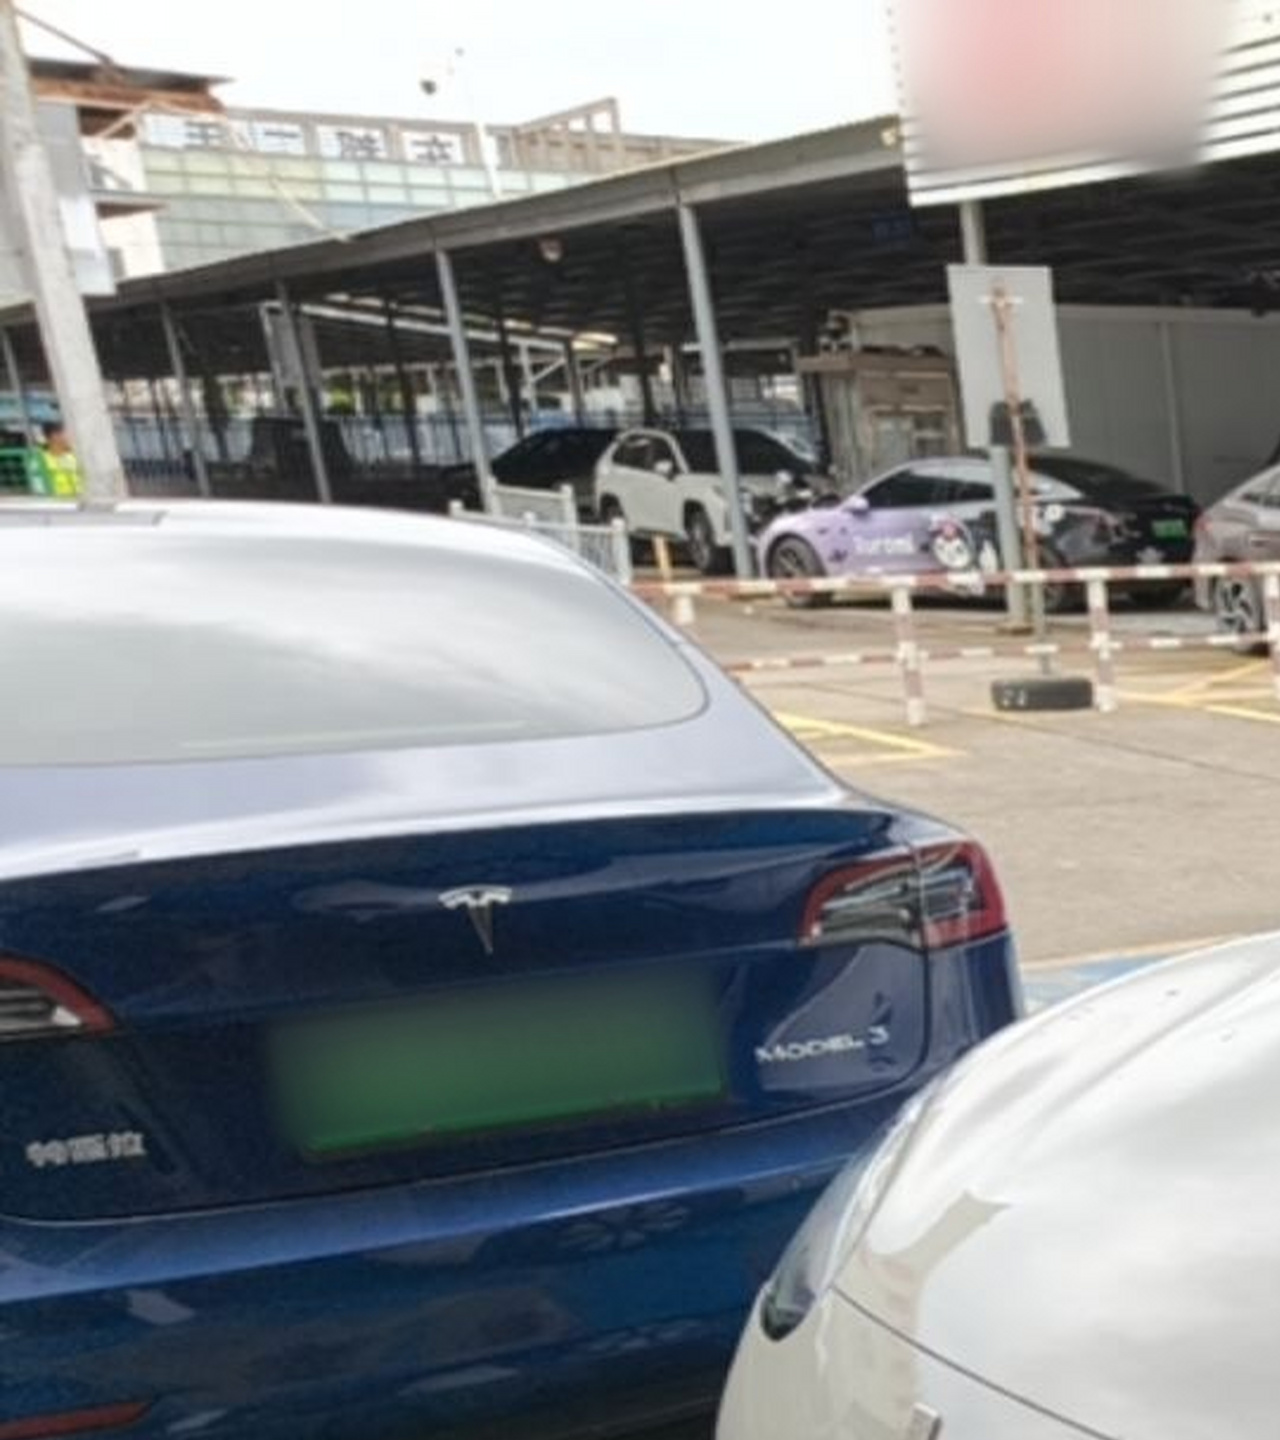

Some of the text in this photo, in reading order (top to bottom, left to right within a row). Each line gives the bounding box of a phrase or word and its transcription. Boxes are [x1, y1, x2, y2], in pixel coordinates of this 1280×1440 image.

[755, 1024, 890, 1064] MODEL 3
[26, 1131, 147, 1167] 特斯拉
